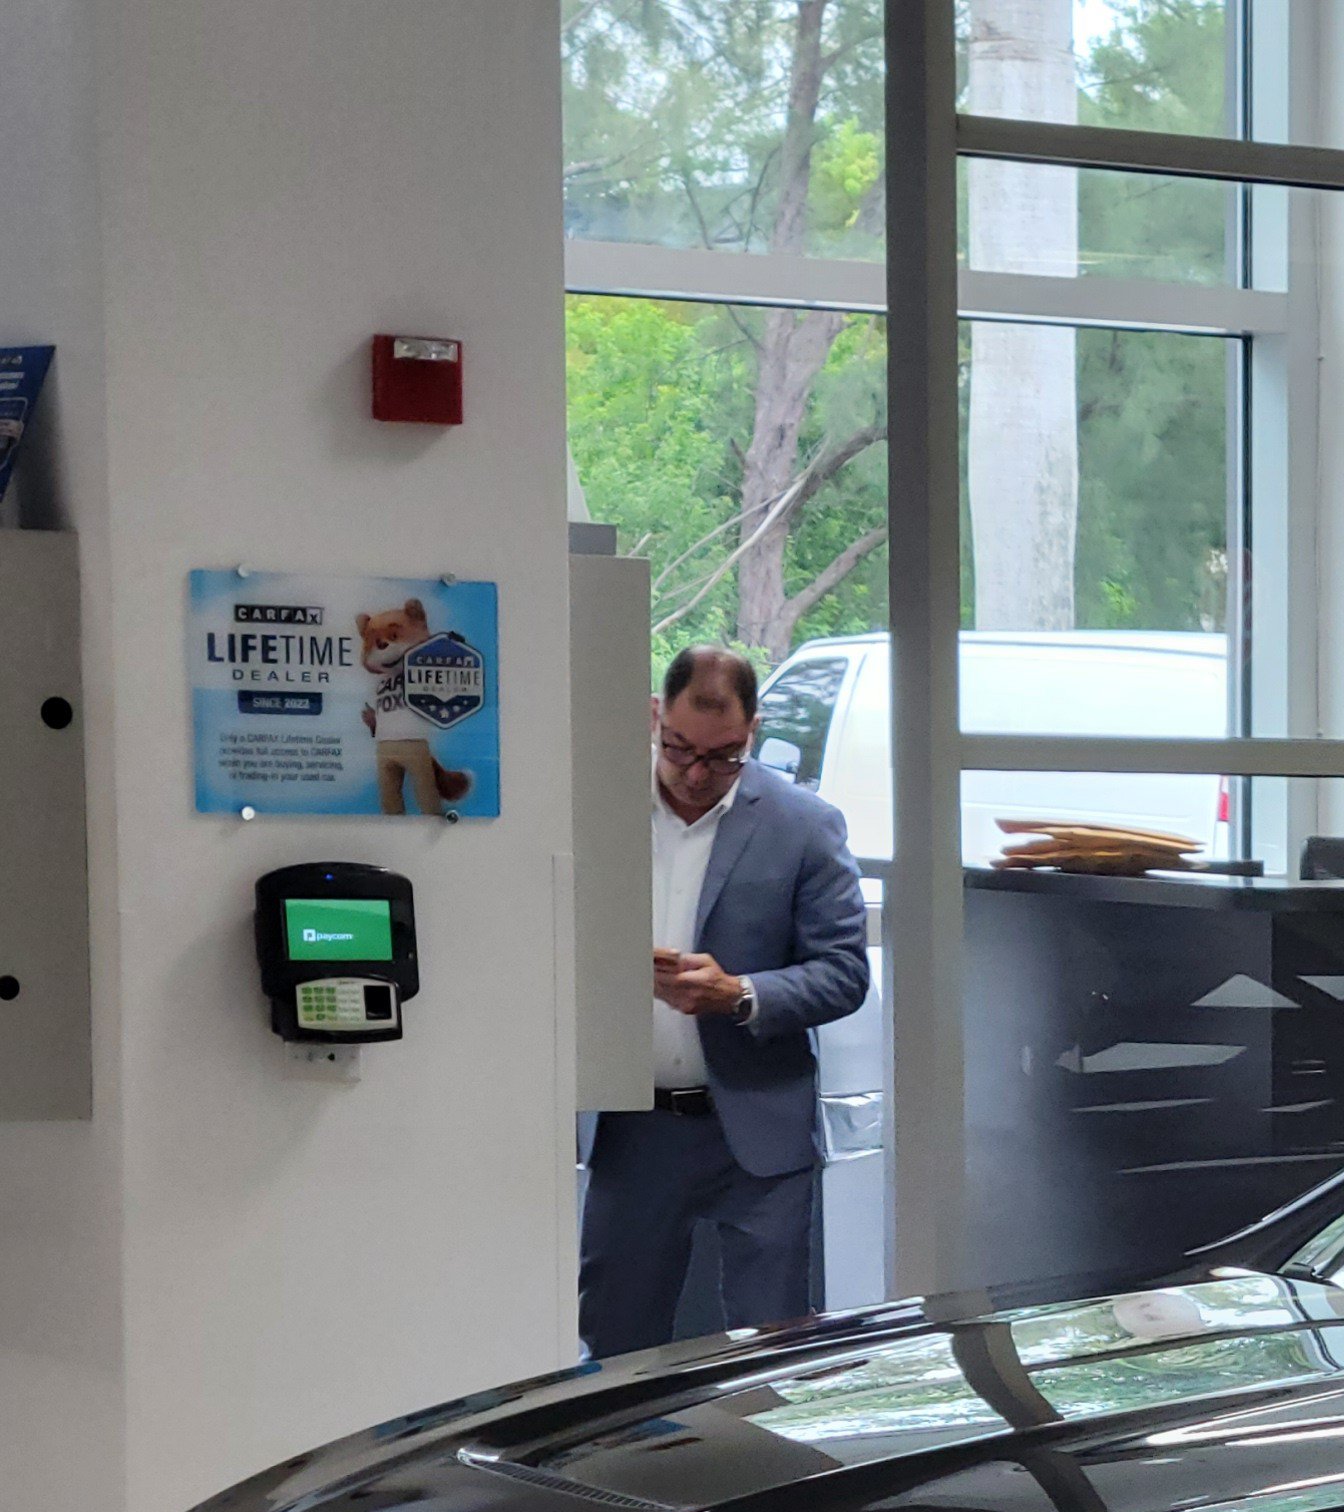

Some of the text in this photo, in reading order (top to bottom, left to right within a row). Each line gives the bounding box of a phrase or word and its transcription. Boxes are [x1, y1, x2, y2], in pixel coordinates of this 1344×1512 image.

[236, 605, 321, 624] CARFAX
[206, 632, 353, 667] LIFETIME
[232, 669, 330, 684] DEALER
[407, 668, 480, 687] LIFETIME
[252, 696, 282, 709] SINCE
[316, 932, 354, 942] paycom
